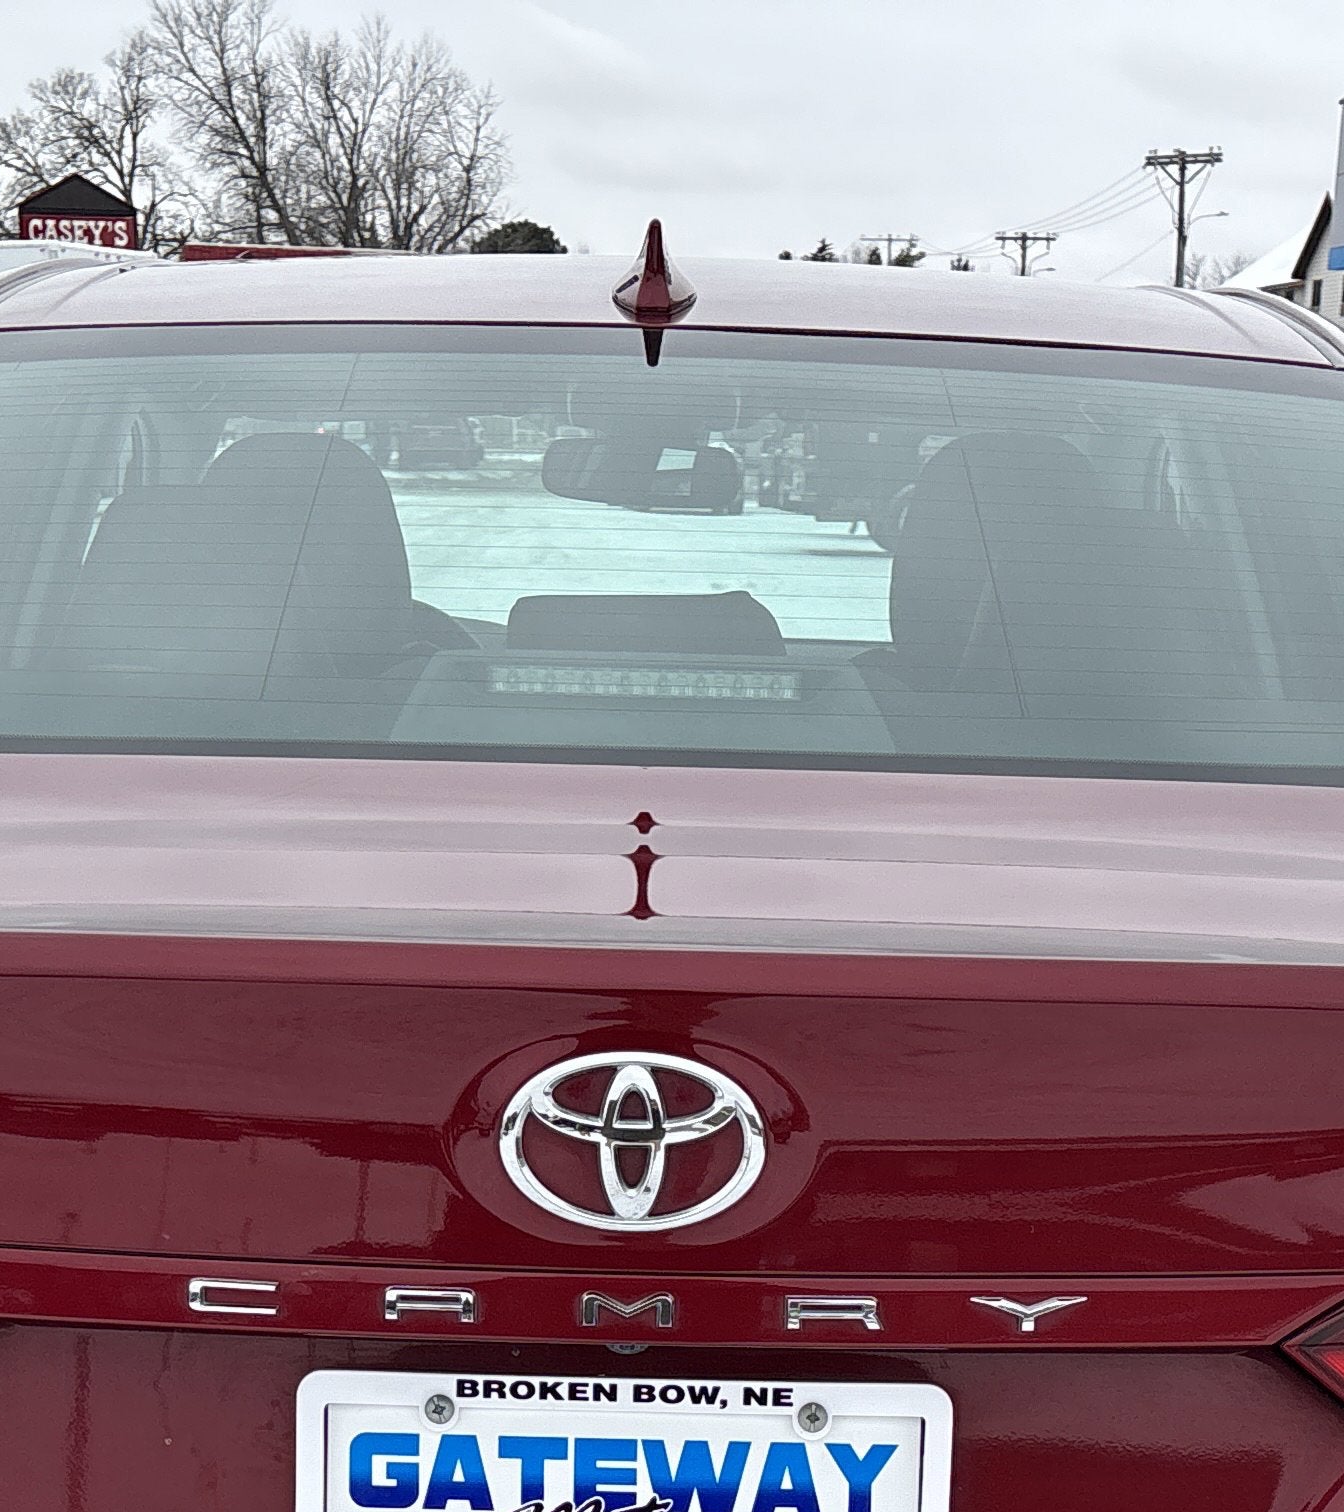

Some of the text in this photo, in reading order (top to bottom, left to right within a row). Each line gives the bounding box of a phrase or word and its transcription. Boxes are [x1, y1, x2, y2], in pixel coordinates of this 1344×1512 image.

[28, 218, 129, 247] CASEY'S
[187, 1277, 1088, 1333] CAMRY
[455, 1379, 794, 1410] BROKEN BOW, NE
